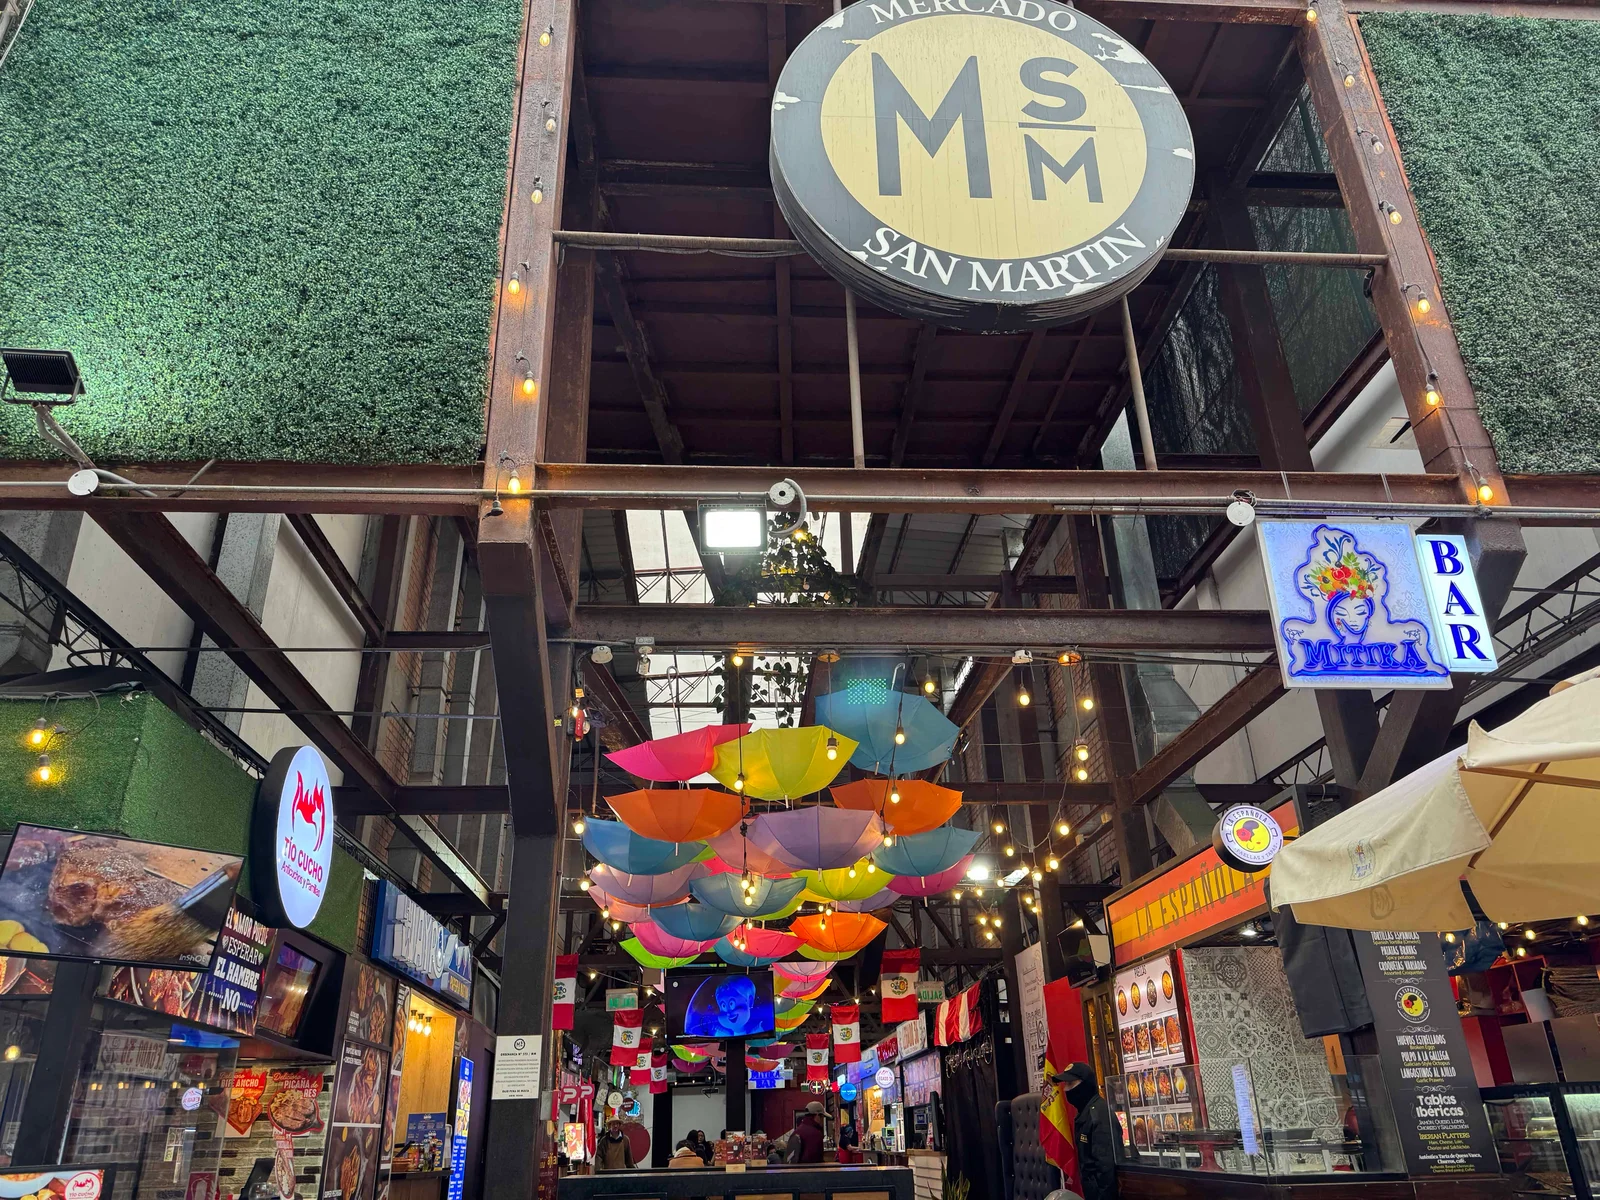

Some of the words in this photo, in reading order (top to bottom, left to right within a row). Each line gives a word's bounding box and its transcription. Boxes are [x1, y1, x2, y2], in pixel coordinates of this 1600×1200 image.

[866, 0, 1078, 32] MERCADO
[1019, 57, 1087, 122] S
[871, 52, 993, 199] M
[1024, 134, 1104, 203] M
[863, 226, 960, 286] SAN
[967, 223, 1147, 293] MARTIN
[1425, 540, 1492, 661] BAR
[1300, 640, 1428, 669] MITIKA
[1233, 810, 1268, 823] ESPAÑOLA
[285, 836, 297, 862] TÍO
[298, 850, 322, 882] CUCHO
[1135, 901, 1155, 943] LA
[1158, 862, 1256, 931] ESPAÑOLA
[225, 907, 234, 929] EL
[233, 911, 253, 938] AMOR
[227, 936, 260, 965] ESPERAR
[214, 956, 226, 979] EL
[226, 962, 260, 992] HAMBRE
[222, 988, 240, 1012] NO
[1396, 1034, 1416, 1046] HUEVOS
[1416, 1034, 1446, 1044] ESTRELLADOS
[1400, 1052, 1417, 1062] PULPO
[1422, 1051, 1428, 1061] LA
[1428, 1050, 1450, 1060] GALLEGA
[236, 1078, 259, 1088] ANCHO
[284, 1077, 310, 1089] PICAÑA
[1400, 1067, 1433, 1078] LANGOSTINOS
[1433, 1067, 1440, 1077] AL
[1440, 1066, 1456, 1077] AJILLO
[303, 1089, 317, 1098] RES
[1416, 1094, 1456, 1106] Tablas
[1416, 1105, 1464, 1118] Ibéricas
